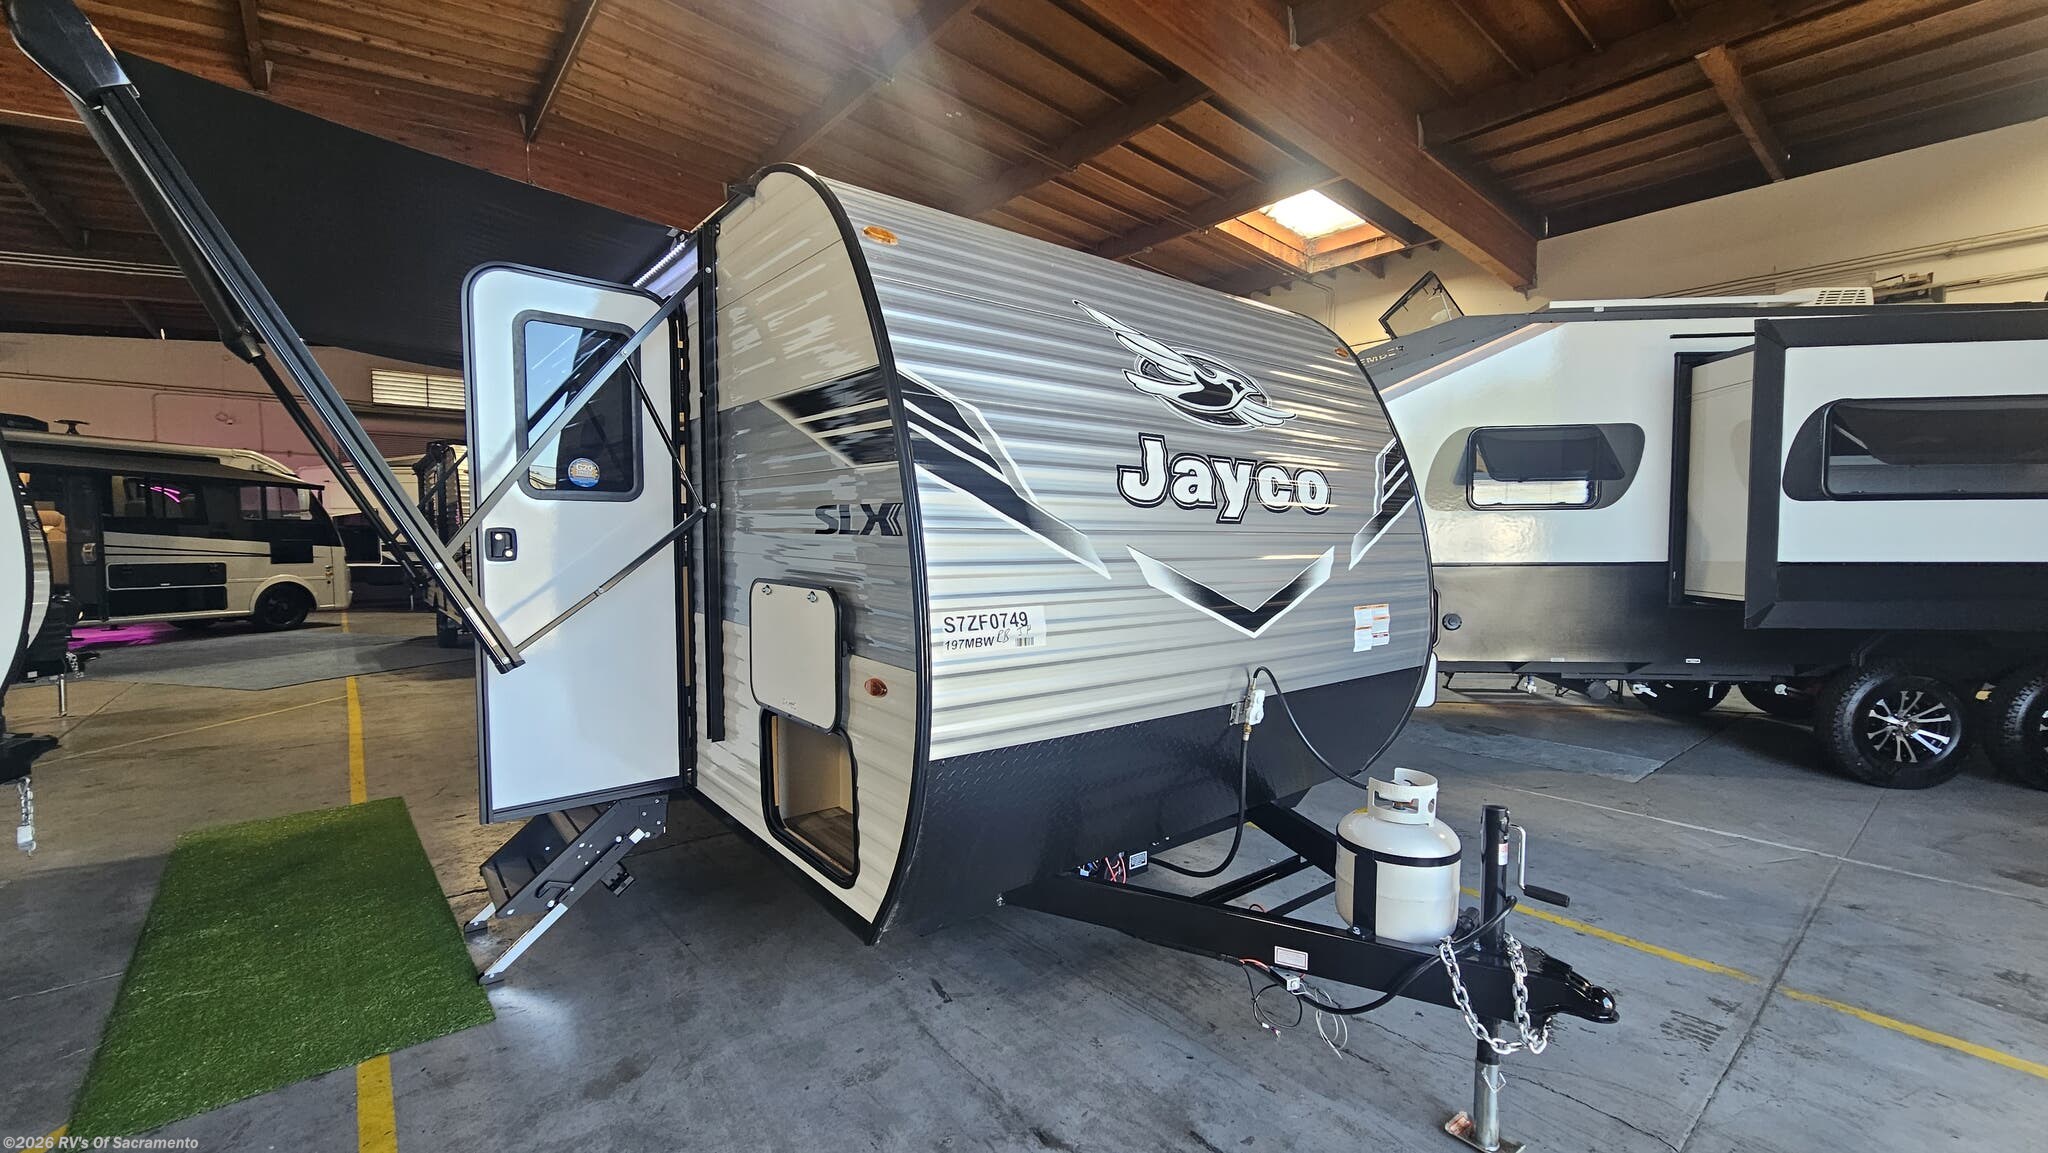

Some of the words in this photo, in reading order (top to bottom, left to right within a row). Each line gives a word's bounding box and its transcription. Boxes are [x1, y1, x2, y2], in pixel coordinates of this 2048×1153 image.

[1116, 432, 1332, 524] Jayco
[815, 503, 904, 536] SLX
[944, 611, 1028, 633] S7ZF0749
[945, 636, 995, 651] 197MBW
